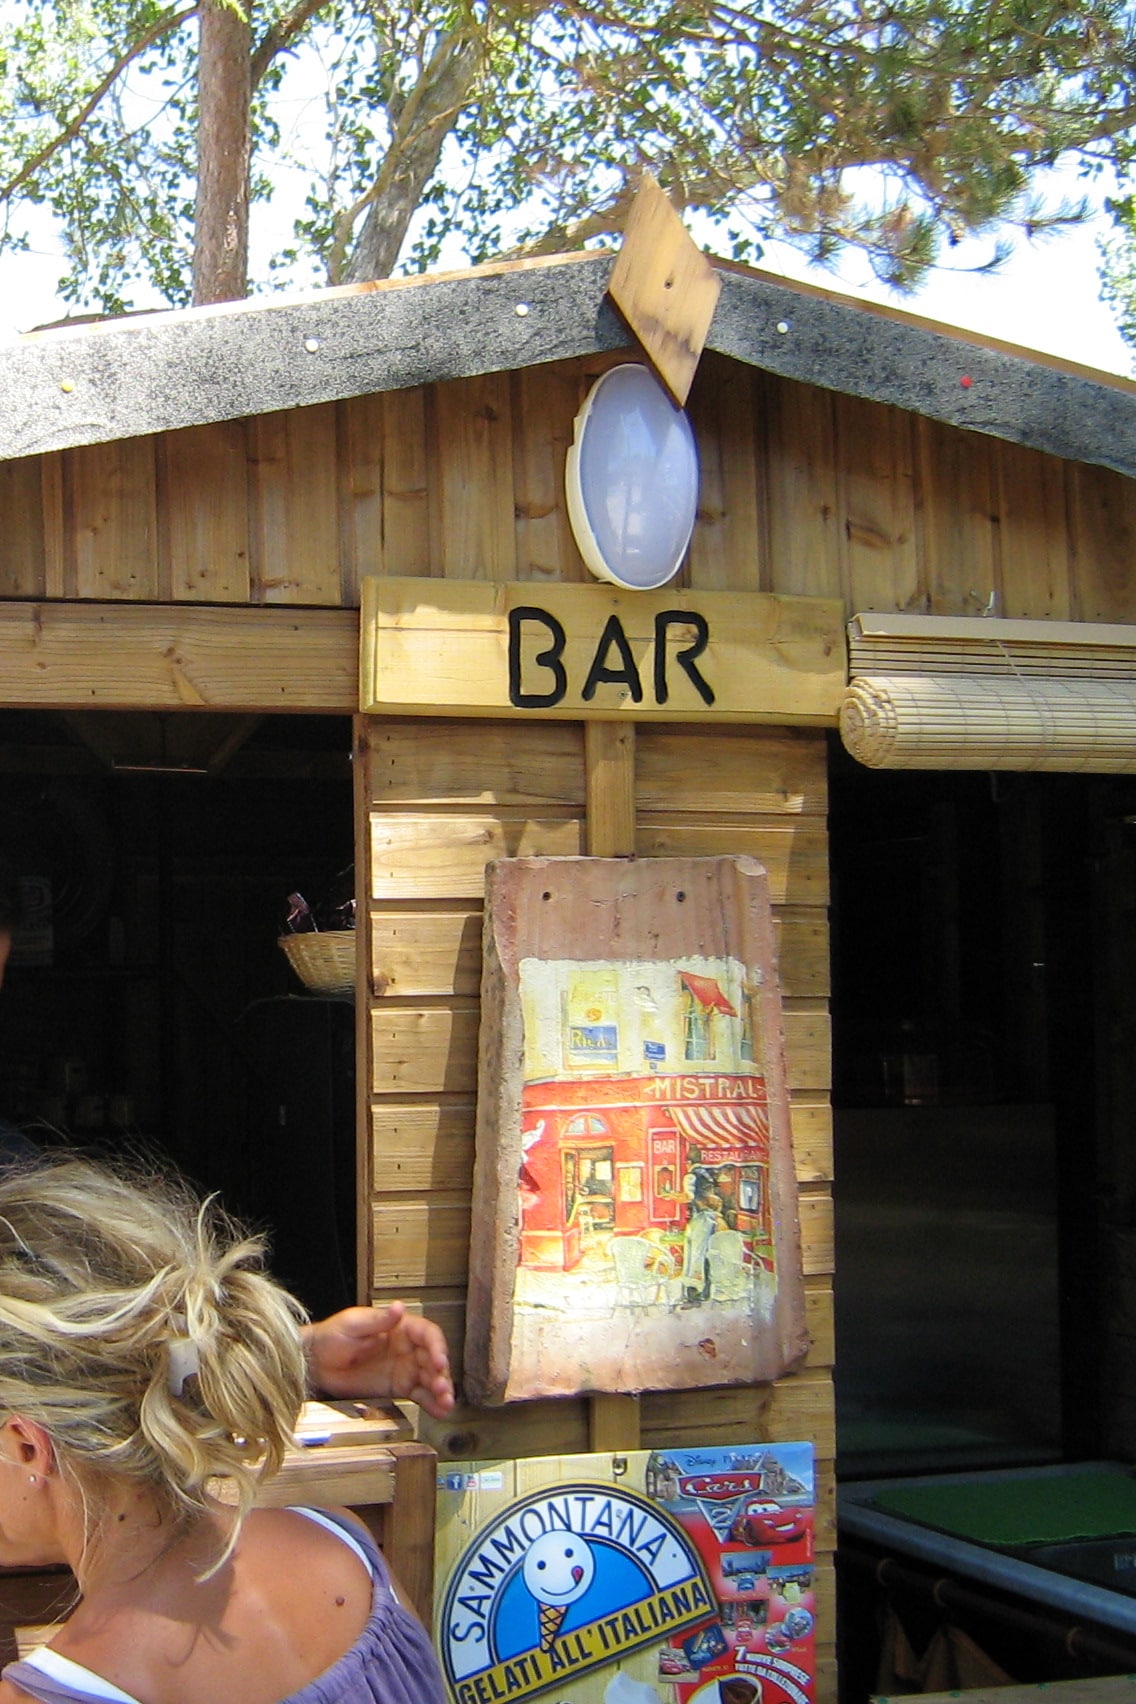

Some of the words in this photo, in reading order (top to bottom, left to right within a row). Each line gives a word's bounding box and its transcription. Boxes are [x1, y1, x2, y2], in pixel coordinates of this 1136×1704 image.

[509, 606, 715, 709] BAR
[654, 1077, 759, 1099] MISTRAL
[653, 1140, 676, 1154] BAR
[685, 1477, 753, 1494] Cars
[452, 1496, 667, 1643] SAMMONTANA
[457, 1654, 543, 1704] GELATI
